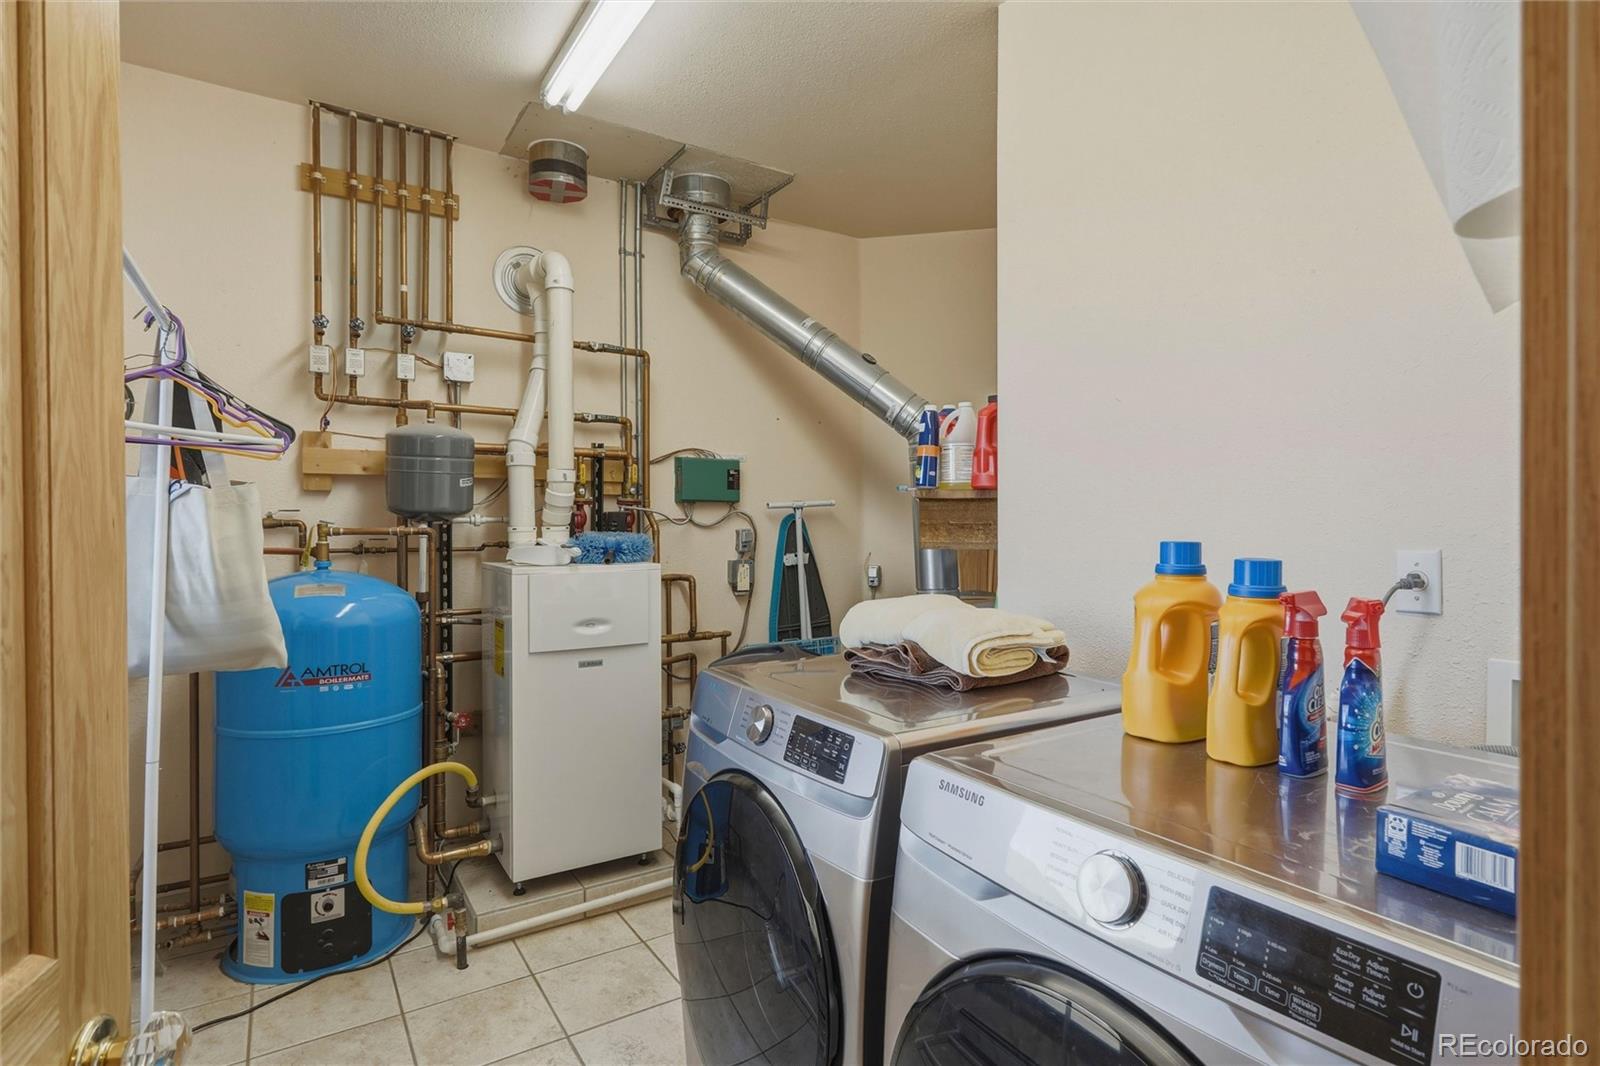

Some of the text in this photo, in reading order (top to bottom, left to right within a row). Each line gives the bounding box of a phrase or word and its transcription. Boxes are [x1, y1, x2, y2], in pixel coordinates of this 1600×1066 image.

[301, 662, 369, 678] AMTROL
[319, 674, 369, 685] BOILERMATE
[938, 779, 985, 807] SAMSUNG
[1366, 959, 1390, 974] Adjust
[1366, 967, 1383, 979] Time
[1265, 986, 1281, 999] Time
[1362, 986, 1386, 1001] Adjust
[1361, 995, 1379, 1007] Time
